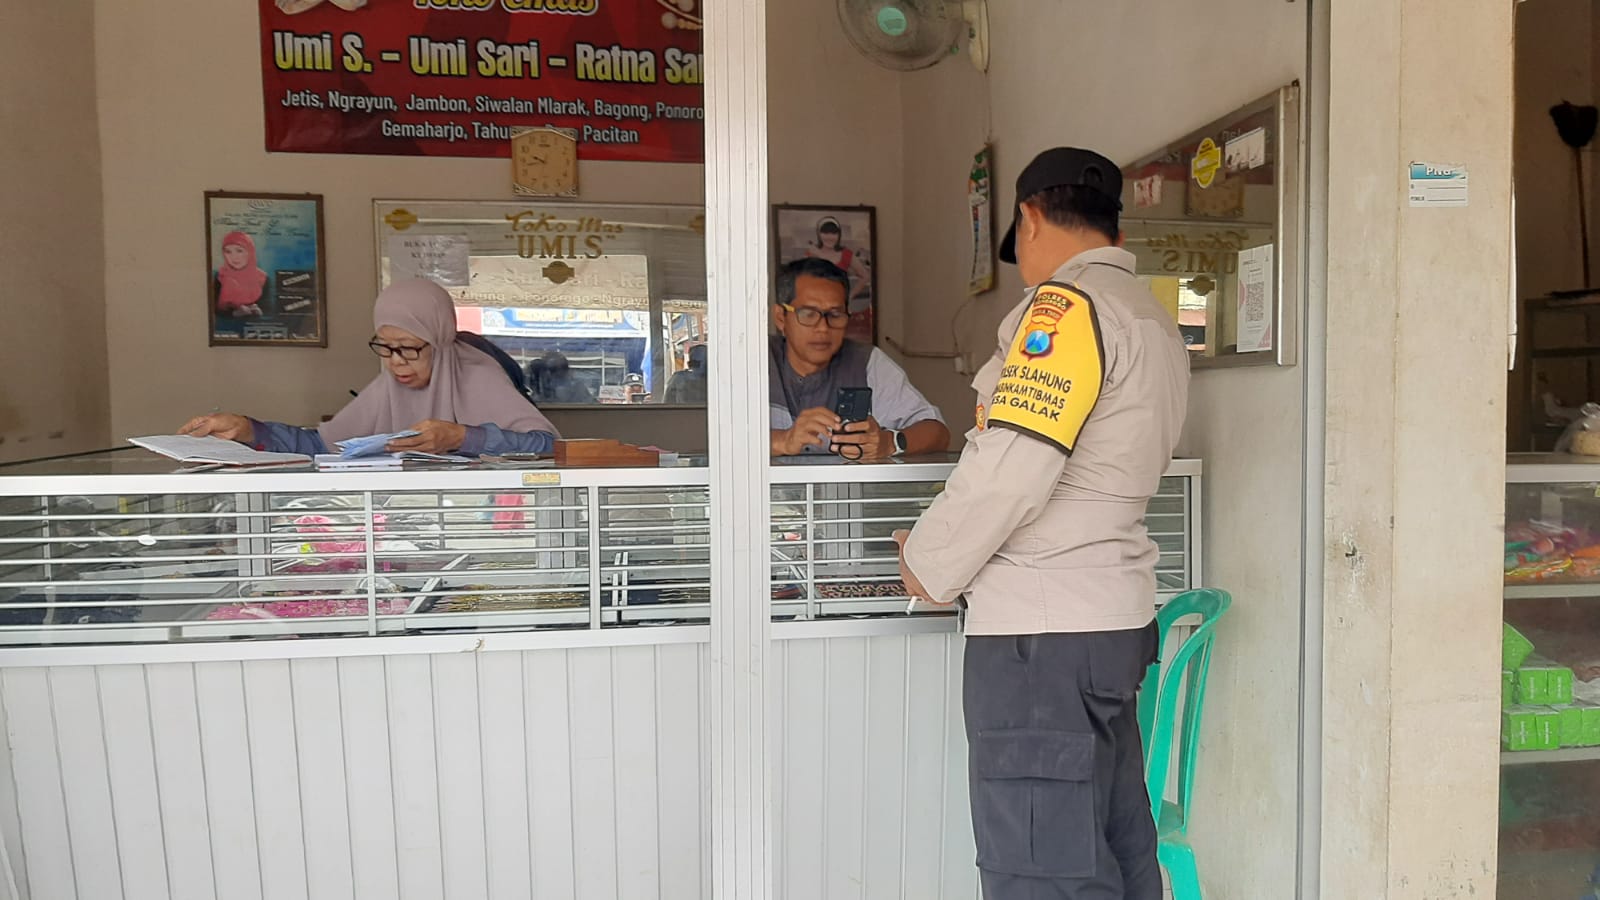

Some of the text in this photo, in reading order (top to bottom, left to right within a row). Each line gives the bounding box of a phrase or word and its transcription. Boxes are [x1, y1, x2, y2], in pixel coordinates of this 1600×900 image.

[272, 31, 333, 71] Umi
[341, 33, 373, 73] S.
[408, 36, 468, 76] Umi
[476, 39, 540, 78] Sari
[575, 43, 657, 83] Ratna
[281, 89, 704, 121] Jetis, Ngrayun, Jambon, Siwalan Mlarak, Bagong, Ponoro
[382, 119, 469, 143] Gemaharjo,
[583, 123, 639, 144] Pacitan
[1020, 365, 1072, 393] SLAHUNG
[1009, 397, 1061, 422] GALAK
